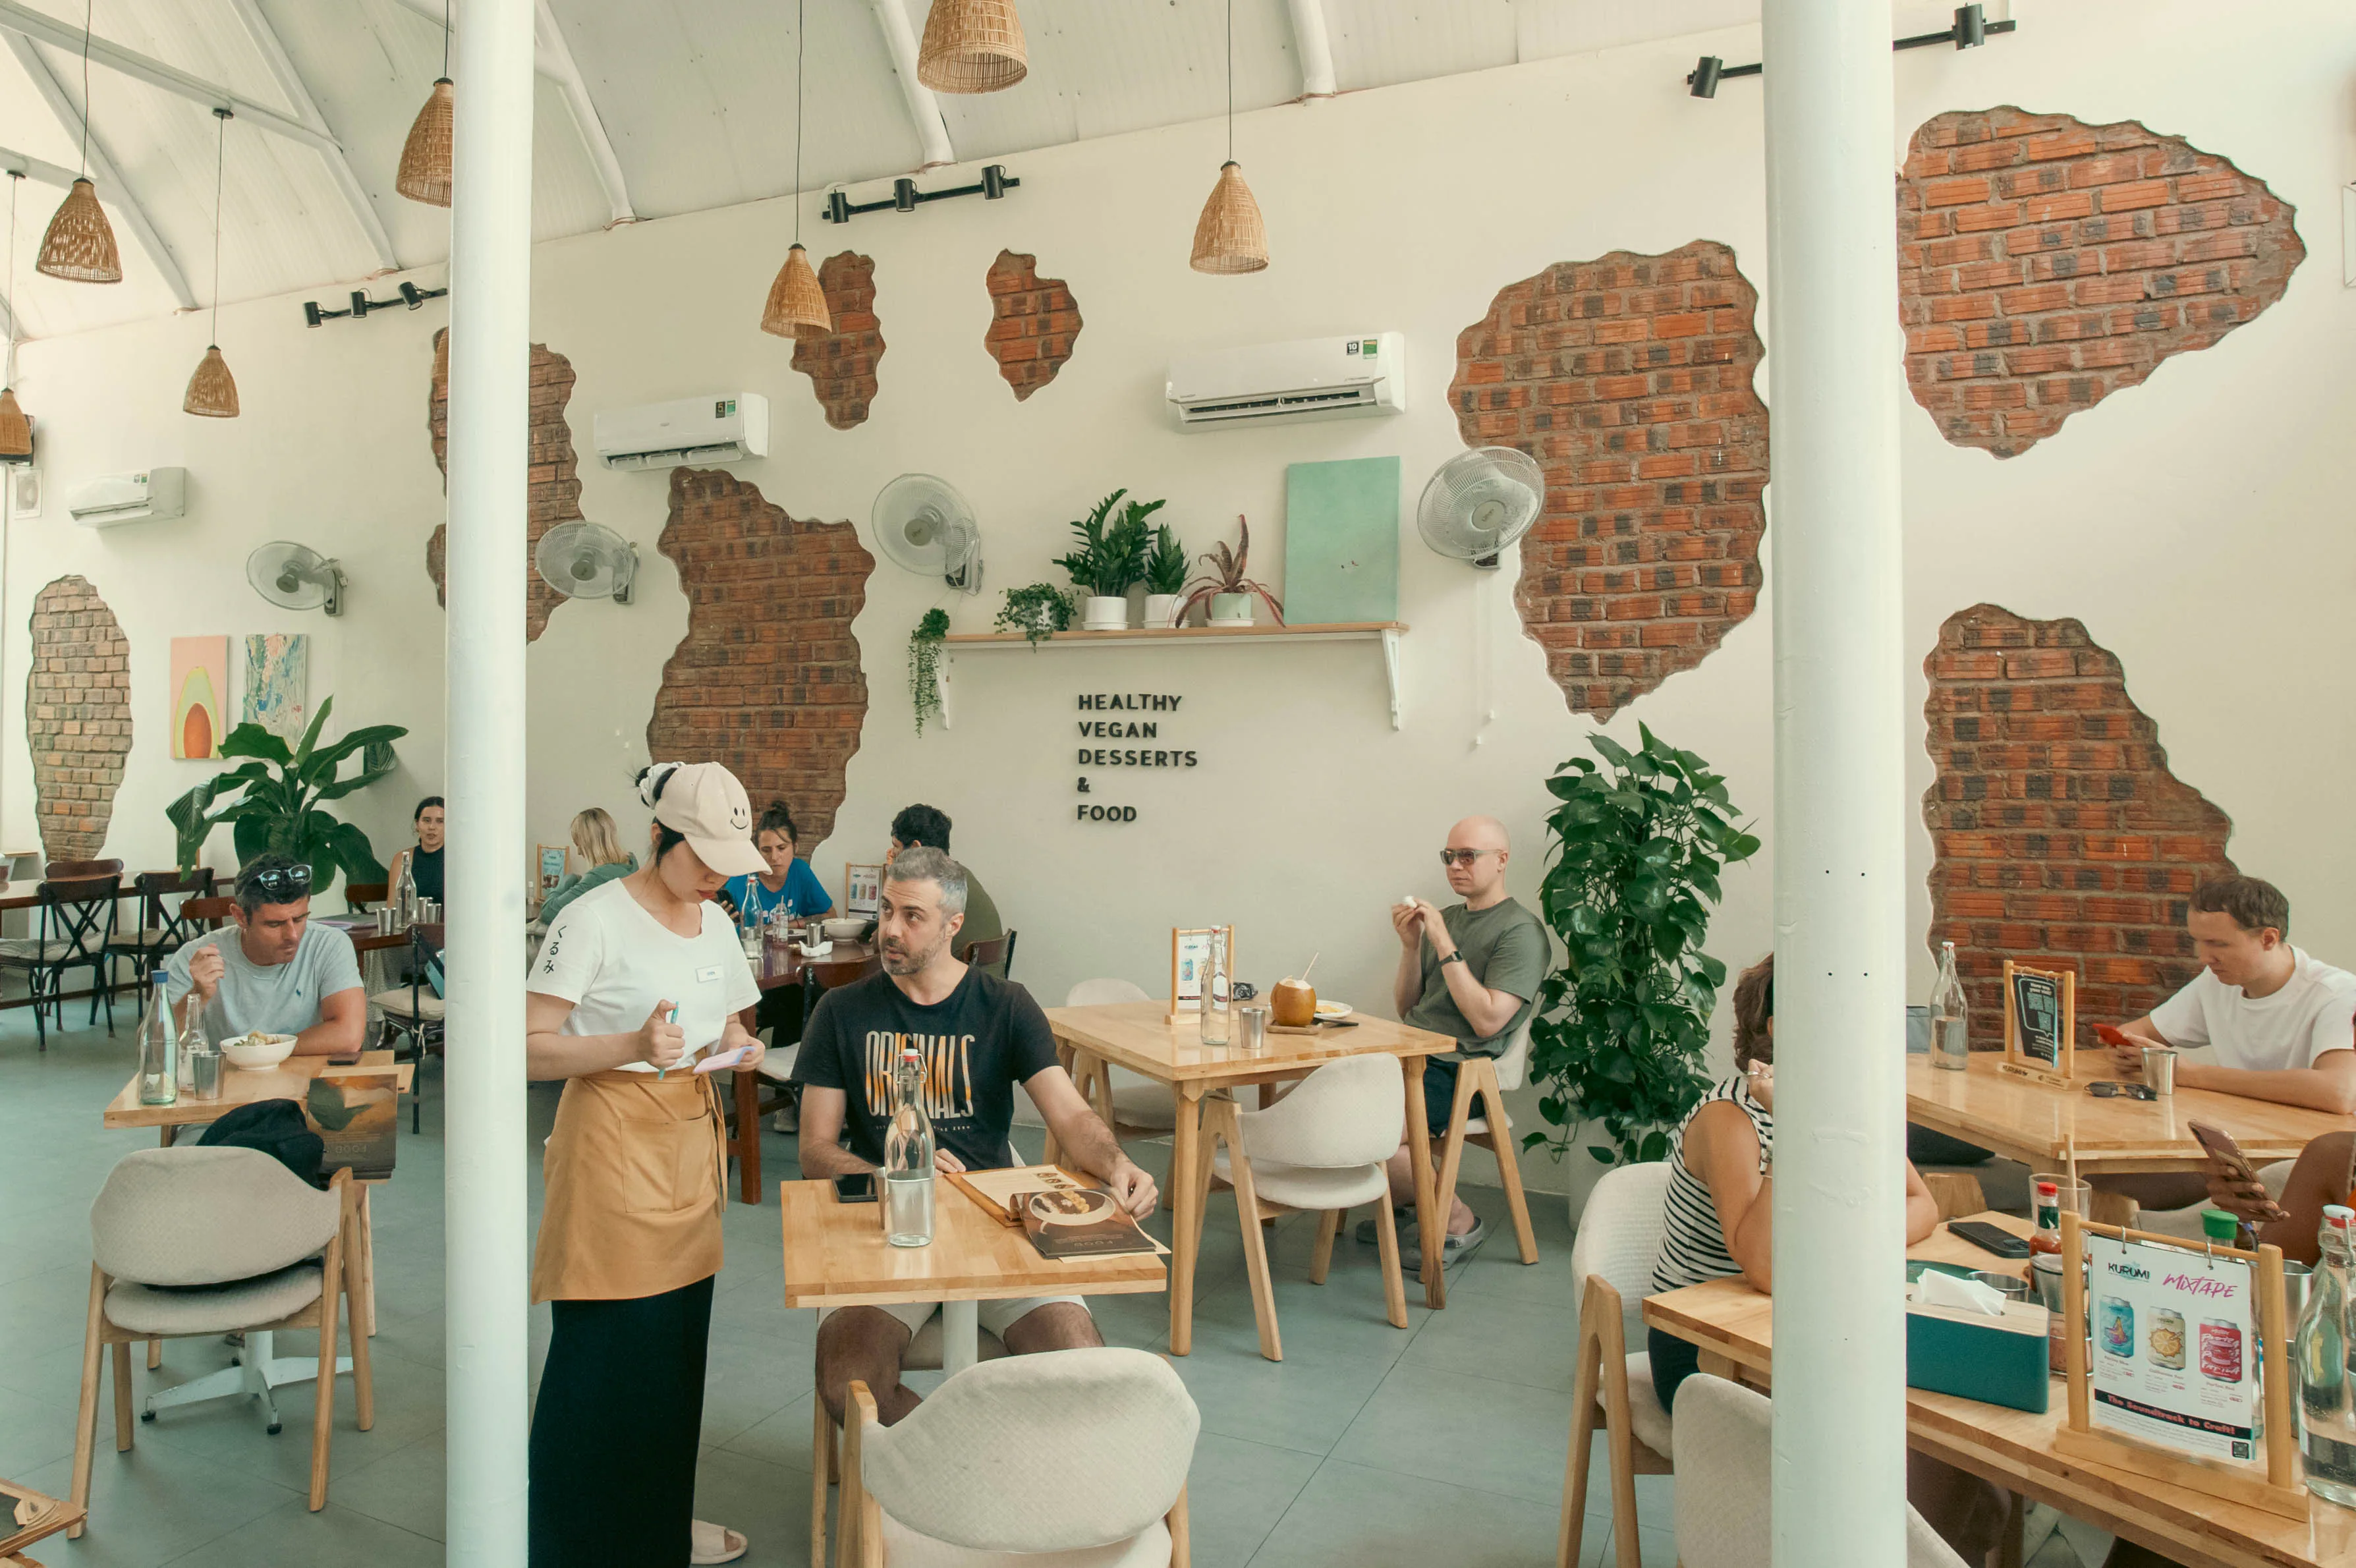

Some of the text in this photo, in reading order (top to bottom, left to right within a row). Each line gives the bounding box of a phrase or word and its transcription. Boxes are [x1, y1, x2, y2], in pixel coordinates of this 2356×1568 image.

[1078, 694, 1182, 712] HEALTHY
[1078, 721, 1157, 738] VEGAN
[1078, 748, 1198, 767] DESSERTS
[1077, 777, 1090, 793] &
[1077, 804, 1137, 822] FOOD
[544, 926, 567, 974] くるみ
[865, 1030, 976, 1119] ORINALS
[2108, 1262, 2150, 1279] KURUMI
[2108, 1394, 2124, 1406] The
[2127, 1401, 2185, 1424] Soundtrack
[2188, 1418, 2201, 1427] to
[2203, 1421, 2235, 1435] Craft!
